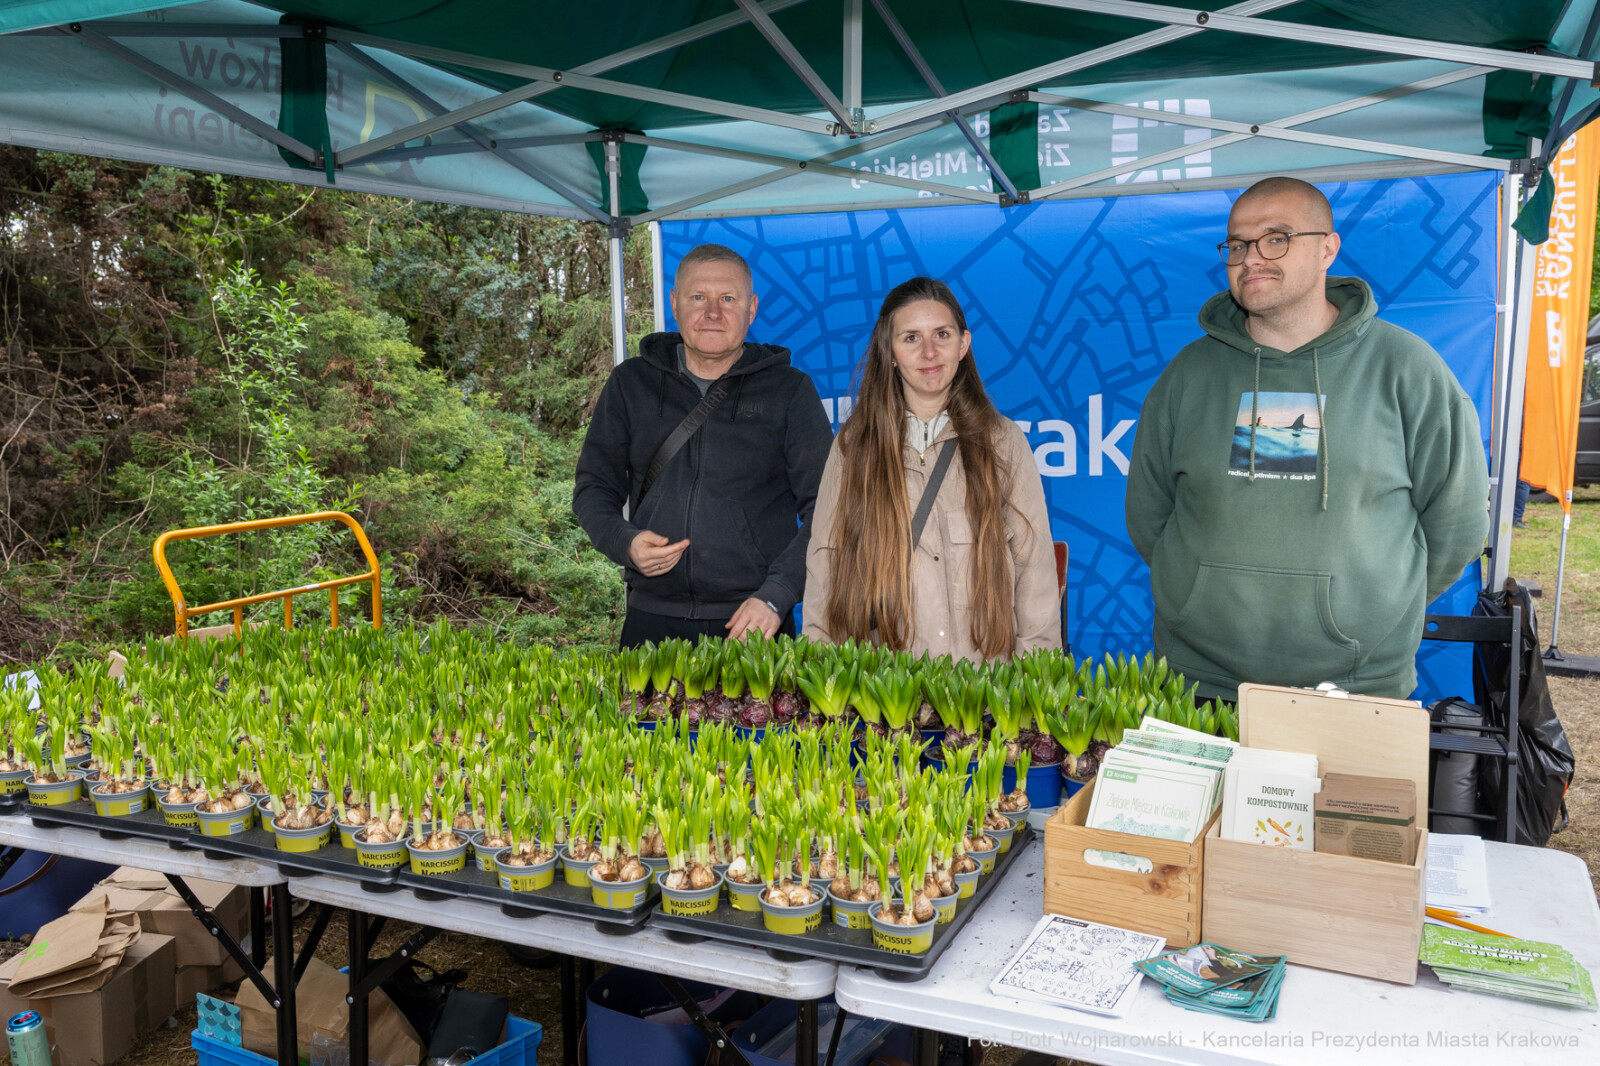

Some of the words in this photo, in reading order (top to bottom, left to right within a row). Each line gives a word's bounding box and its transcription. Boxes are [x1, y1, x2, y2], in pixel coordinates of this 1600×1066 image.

[1253, 472, 1281, 480] ptimism
[1262, 785, 1295, 797] DOMOWY
[1247, 797, 1309, 812] KOMPOSTOWNIK
[362, 852, 401, 861] NARCISSUS
[420, 858, 460, 868] NARCISSUS
[670, 899, 711, 909] NARCISSUS
